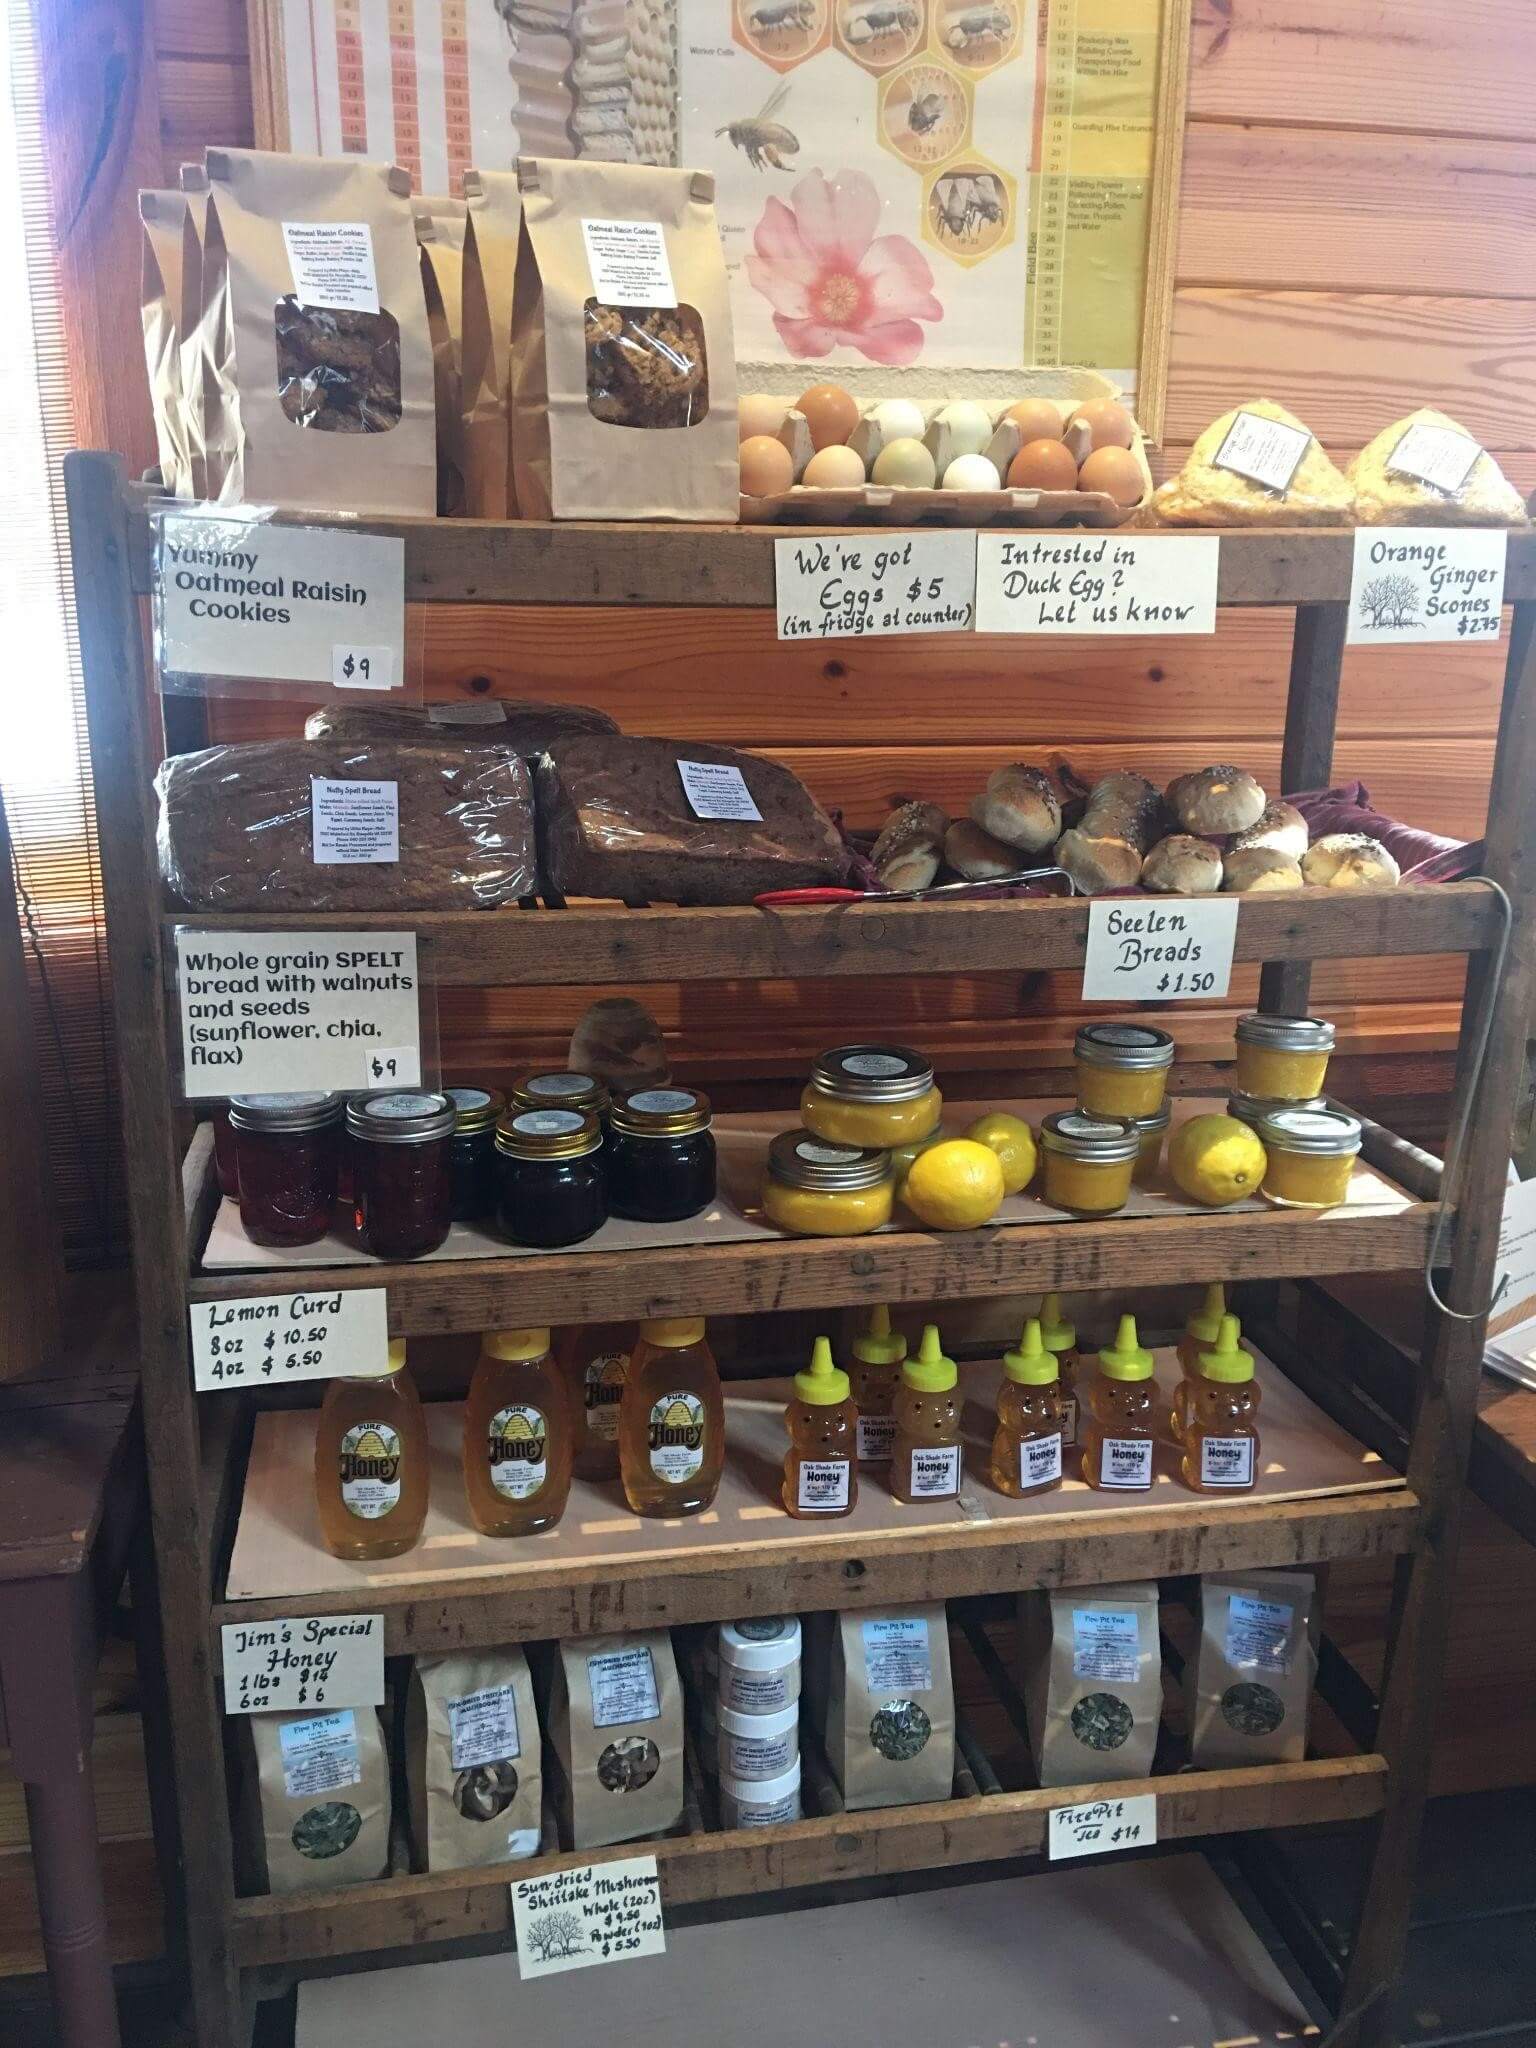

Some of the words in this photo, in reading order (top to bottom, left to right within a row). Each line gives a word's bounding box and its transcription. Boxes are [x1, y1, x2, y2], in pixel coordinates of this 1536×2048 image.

[288, 229, 315, 237] Oatmeal
[338, 229, 363, 237] Cookies
[588, 225, 612, 233] Oatmeal
[633, 227, 657, 236] Cookies
[168, 544, 259, 572] Yummy
[795, 542, 862, 575] We've
[874, 542, 912, 580] got
[1001, 542, 1104, 565] Intrested
[1114, 544, 1136, 565] in
[1370, 541, 1447, 570] Orange
[175, 571, 284, 598] Oatmeal
[292, 580, 367, 606] Raisin
[1002, 570, 1062, 599] Duck
[1429, 566, 1498, 594] Ginger
[820, 578, 885, 614] Eggs
[1425, 597, 1490, 617] Scones
[189, 599, 291, 624] Cookies
[782, 612, 812, 636] (in
[818, 610, 874, 635] fridge
[883, 605, 902, 627] at
[905, 602, 973, 626] counter)
[1038, 600, 1076, 625] Let
[1092, 603, 1118, 623] us
[1127, 599, 1195, 621] know
[1456, 616, 1500, 636] $2.75
[327, 787, 343, 795] Nutty
[345, 787, 360, 795] Spelt
[1107, 910, 1187, 935] Seelen
[186, 952, 259, 973] Whole
[266, 951, 329, 974] grain
[336, 951, 404, 968] SPELT
[1114, 938, 1202, 973] Breads
[187, 975, 259, 994] bread
[266, 975, 315, 994] with
[323, 973, 413, 991] walnuts
[189, 999, 234, 1020] and
[241, 998, 310, 1015] seeds
[191, 1046, 244, 1065] flax)
[208, 1304, 279, 1329] Lemon
[290, 1293, 343, 1320] Curd
[358, 1423, 381, 1431] PURE
[648, 1423, 703, 1450] Honey
[864, 1427, 895, 1438] Honey
[488, 1437, 546, 1462] Honey
[1029, 1448, 1056, 1462] Honey
[1112, 1449, 1145, 1462] Honey
[1208, 1448, 1241, 1462] Honey
[339, 1453, 400, 1482] Honey
[807, 1471, 840, 1484] Honey
[917, 1462, 949, 1474] Honey
[235, 1624, 291, 1653] Jim's
[303, 1619, 374, 1645] Special
[267, 1650, 337, 1672] Honey
[1073, 1823, 1103, 1842] Tea
[583, 1898, 620, 1917] Whole
[590, 1926, 633, 1942] Powder
